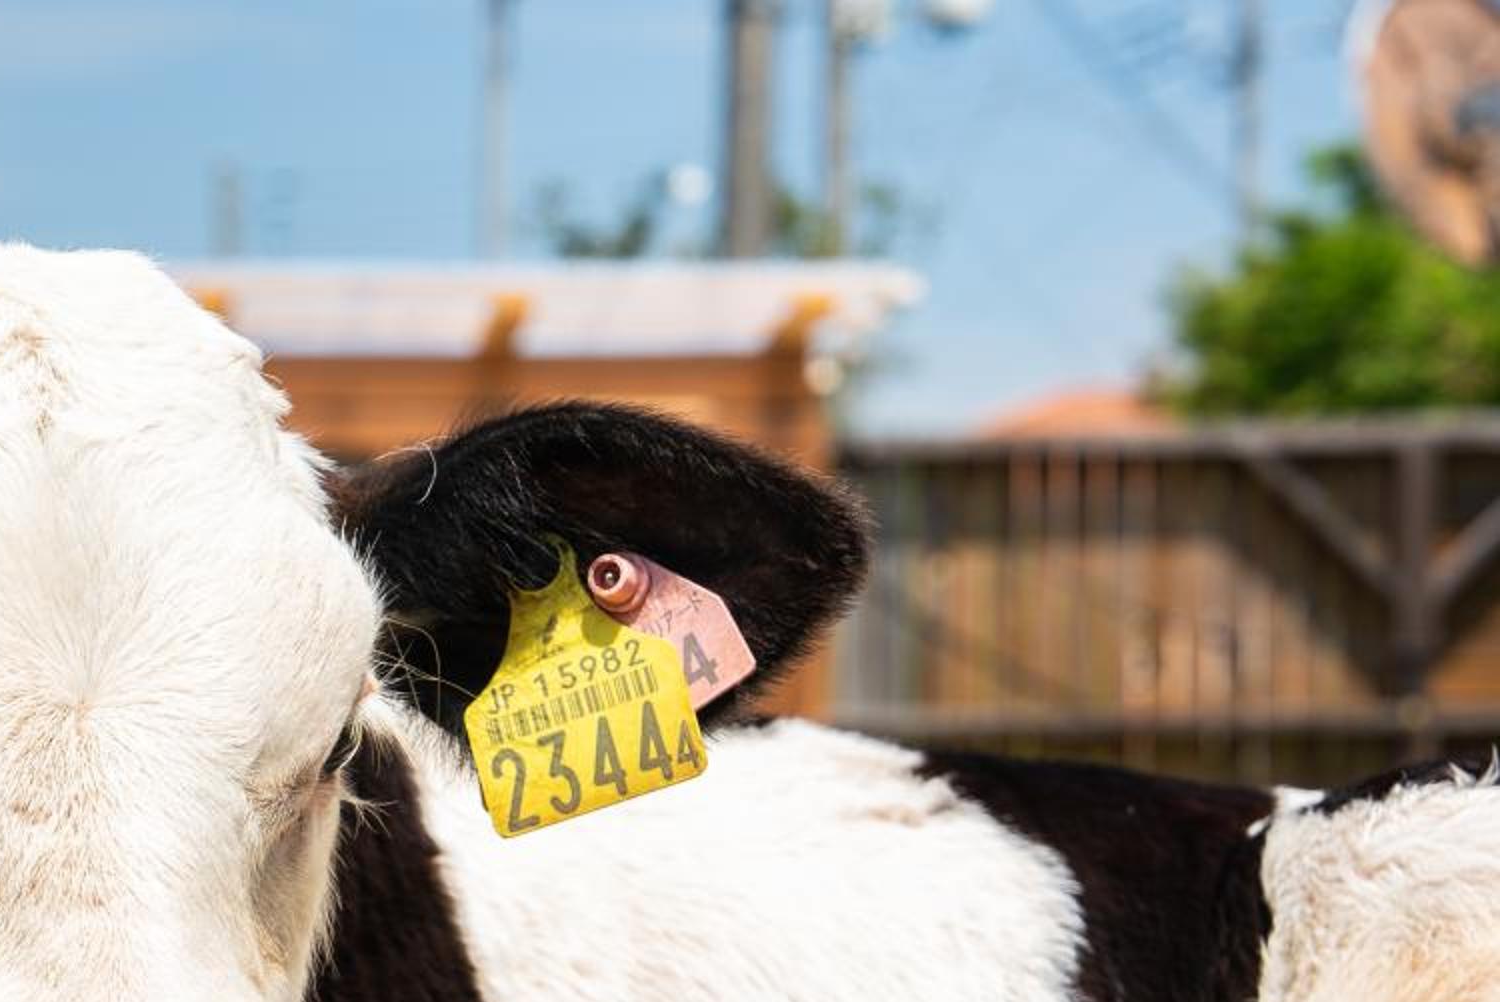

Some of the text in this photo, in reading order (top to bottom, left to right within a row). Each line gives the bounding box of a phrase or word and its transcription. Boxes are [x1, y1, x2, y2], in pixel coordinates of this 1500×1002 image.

[487, 638, 646, 714] JP 15982
[683, 631, 719, 687] 4
